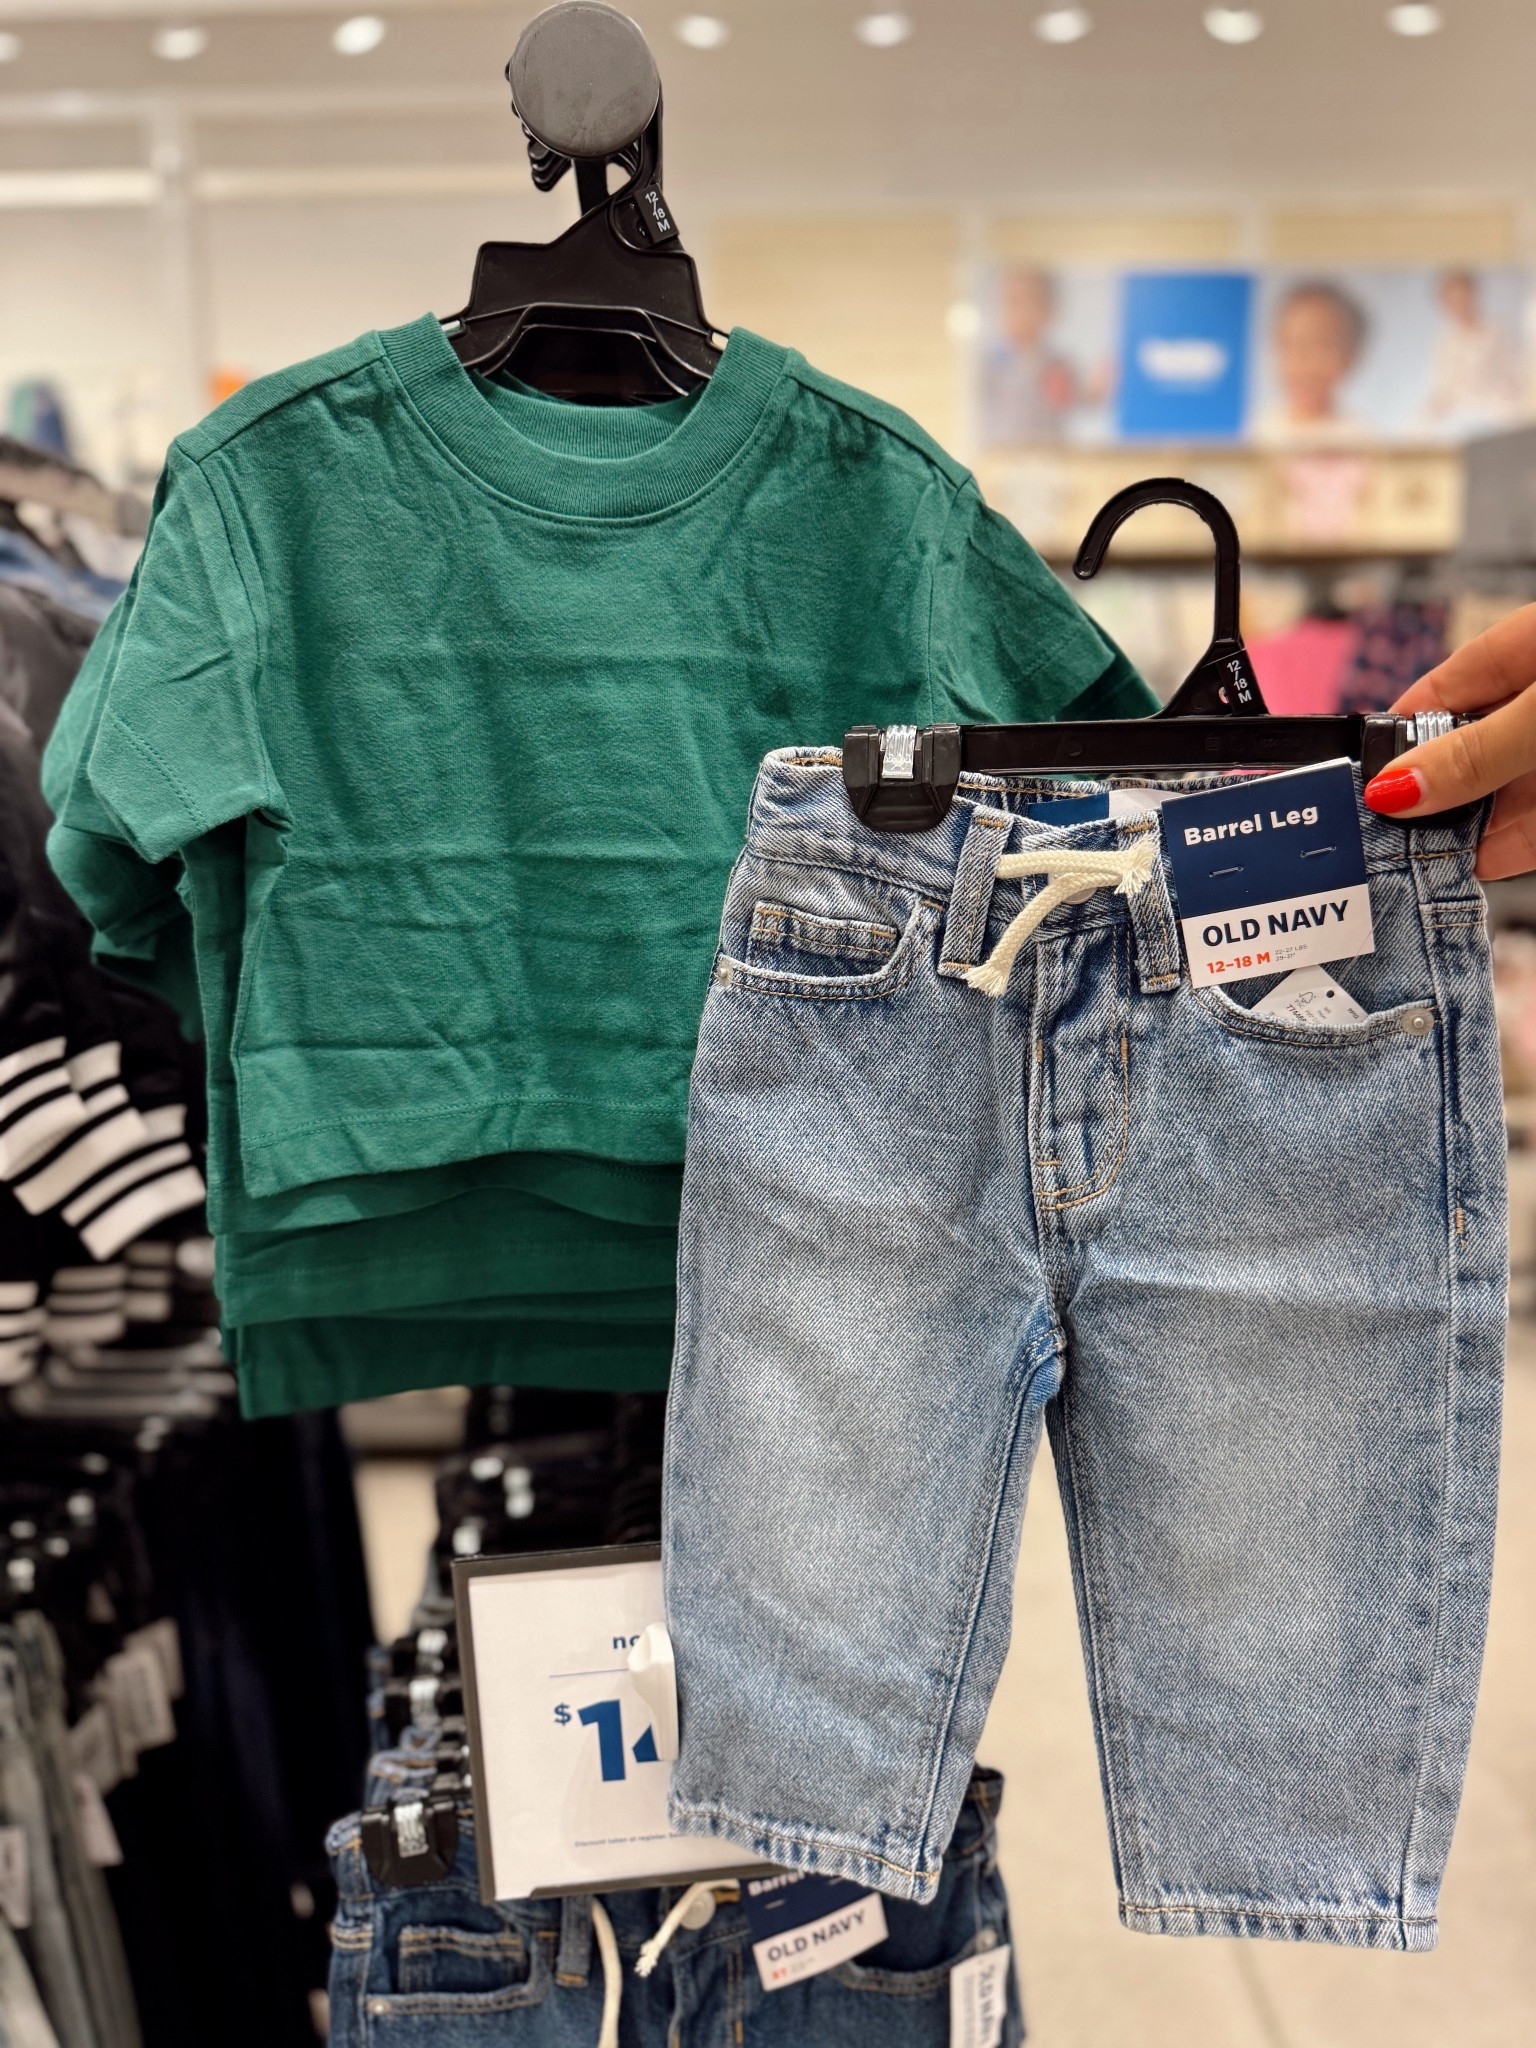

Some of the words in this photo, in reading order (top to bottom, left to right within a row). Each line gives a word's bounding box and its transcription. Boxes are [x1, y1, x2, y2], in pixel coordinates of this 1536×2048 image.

[645, 191, 659, 203] 12
[653, 208, 665, 220] 18
[657, 218, 671, 232] M
[1227, 660, 1241, 672] 12
[1234, 678, 1248, 690] 18
[1238, 690, 1252, 703] M
[1184, 813, 1262, 846] Barrel
[1271, 805, 1318, 829] Leg
[1202, 918, 1260, 947] OLD
[1267, 900, 1349, 936] NAVY
[1206, 953, 1252, 974] 12-18
[1257, 951, 1271, 965] M
[612, 1634, 641, 1649] no
[767, 1937, 808, 1961] OLD
[812, 1909, 865, 1946] NAVY
